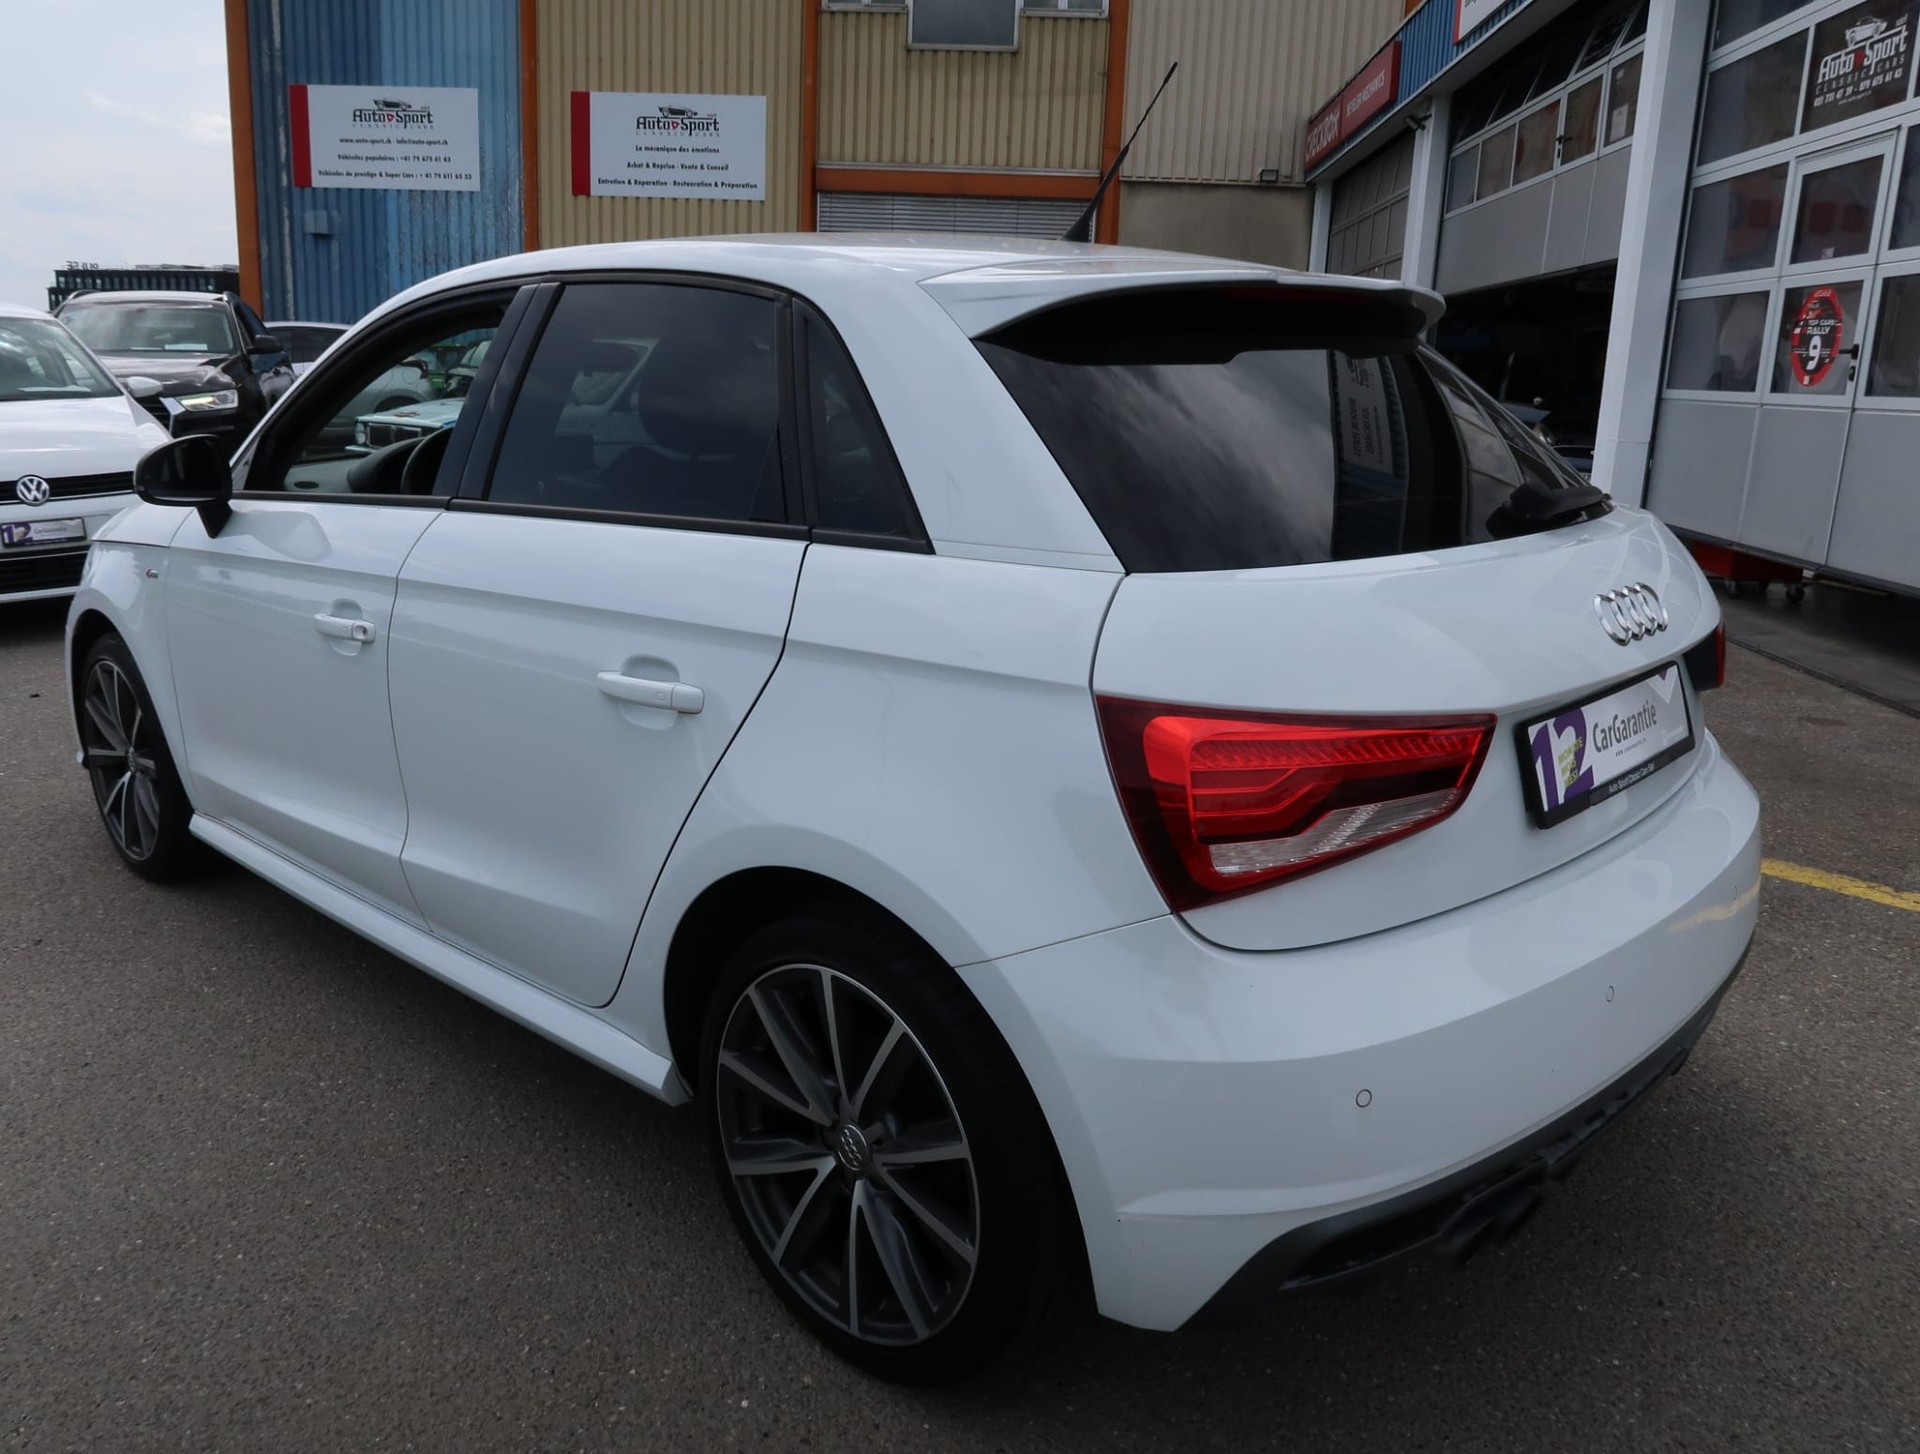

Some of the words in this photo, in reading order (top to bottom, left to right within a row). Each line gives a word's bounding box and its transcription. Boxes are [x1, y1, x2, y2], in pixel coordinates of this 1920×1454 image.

[1817, 50, 1855, 83] Auto
[1863, 25, 1908, 75] Sport
[1815, 69, 1867, 95] CLASSIC
[1877, 55, 1905, 72] CARS
[352, 109, 386, 123] Auto
[395, 110, 433, 129] Sport
[636, 116, 670, 130] Auto
[681, 117, 719, 136] Sport
[678, 145, 690, 153] des
[385, 171, 401, 179] Super
[626, 161, 644, 169] Achat
[652, 162, 676, 171] Reprise
[706, 163, 729, 171] Conseil
[673, 180, 712, 188] Restauration
[1806, 326, 1831, 334] RALLY
[1805, 335, 1821, 371] 9
[1592, 699, 1657, 753] CarGarantie
[1530, 707, 1595, 813] 12
